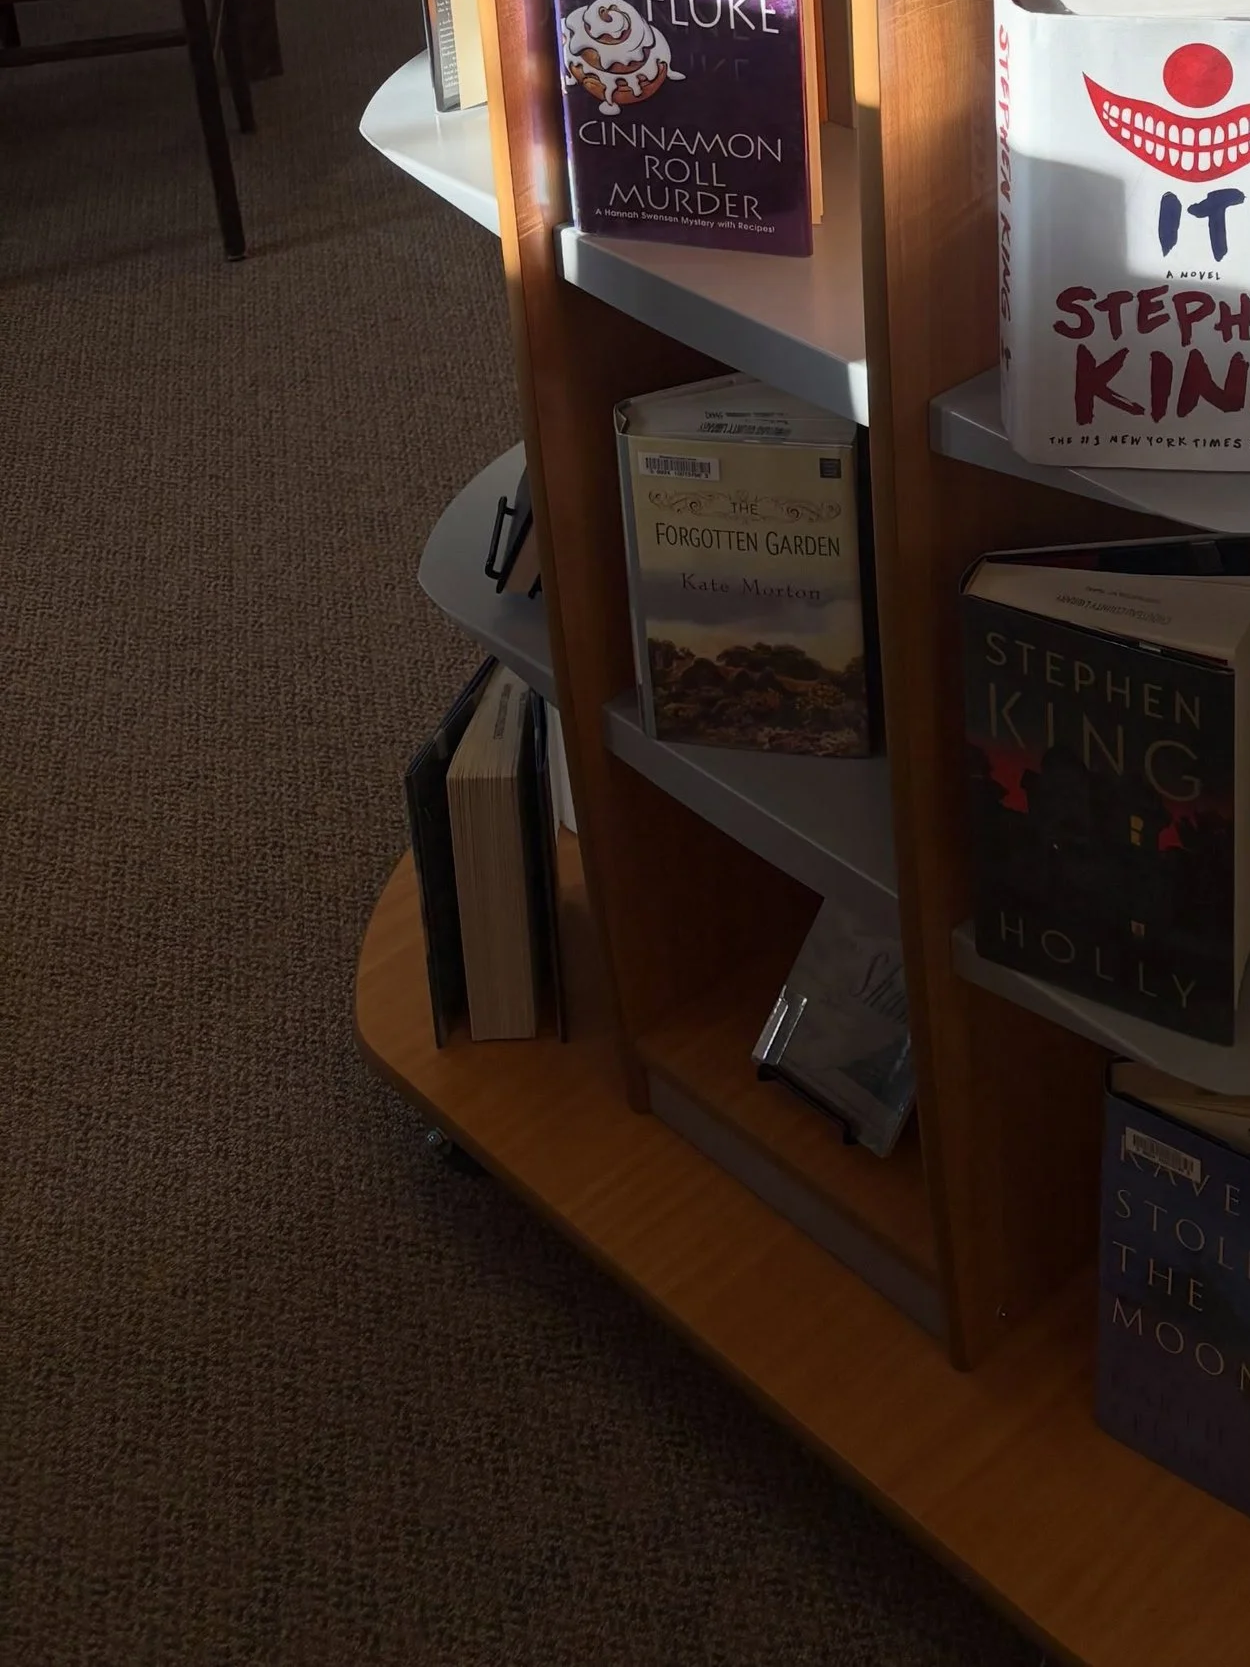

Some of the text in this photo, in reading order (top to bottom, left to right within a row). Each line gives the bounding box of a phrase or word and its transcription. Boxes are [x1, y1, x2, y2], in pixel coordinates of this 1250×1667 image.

[999, 23, 1012, 204] STEPHEN
[579, 120, 782, 163] CINNAMON
[645, 155, 727, 189] ROLL
[595, 207, 602, 215] A
[604, 208, 639, 219] Hannah
[681, 215, 715, 229] Mystery
[717, 220, 736, 229] with
[609, 183, 763, 221] MURDER
[1158, 187, 1247, 263] IT
[1000, 210, 1012, 323] KING
[1166, 270, 1222, 281] A NOVEL
[1049, 436, 1073, 446] THE
[1109, 435, 1141, 446] NEW
[1146, 436, 1188, 447] YORK
[1193, 437, 1243, 449] TIMES
[730, 502, 759, 516] THE
[655, 522, 840, 557] FORGOTTEN GARDEN
[681, 572, 822, 601] Kate Morton
[984, 631, 1201, 731] STEPHEN
[988, 682, 1203, 803] KING
[1000, 911, 1197, 1010] HOLLY
[1112, 1240, 1204, 1313] THE
